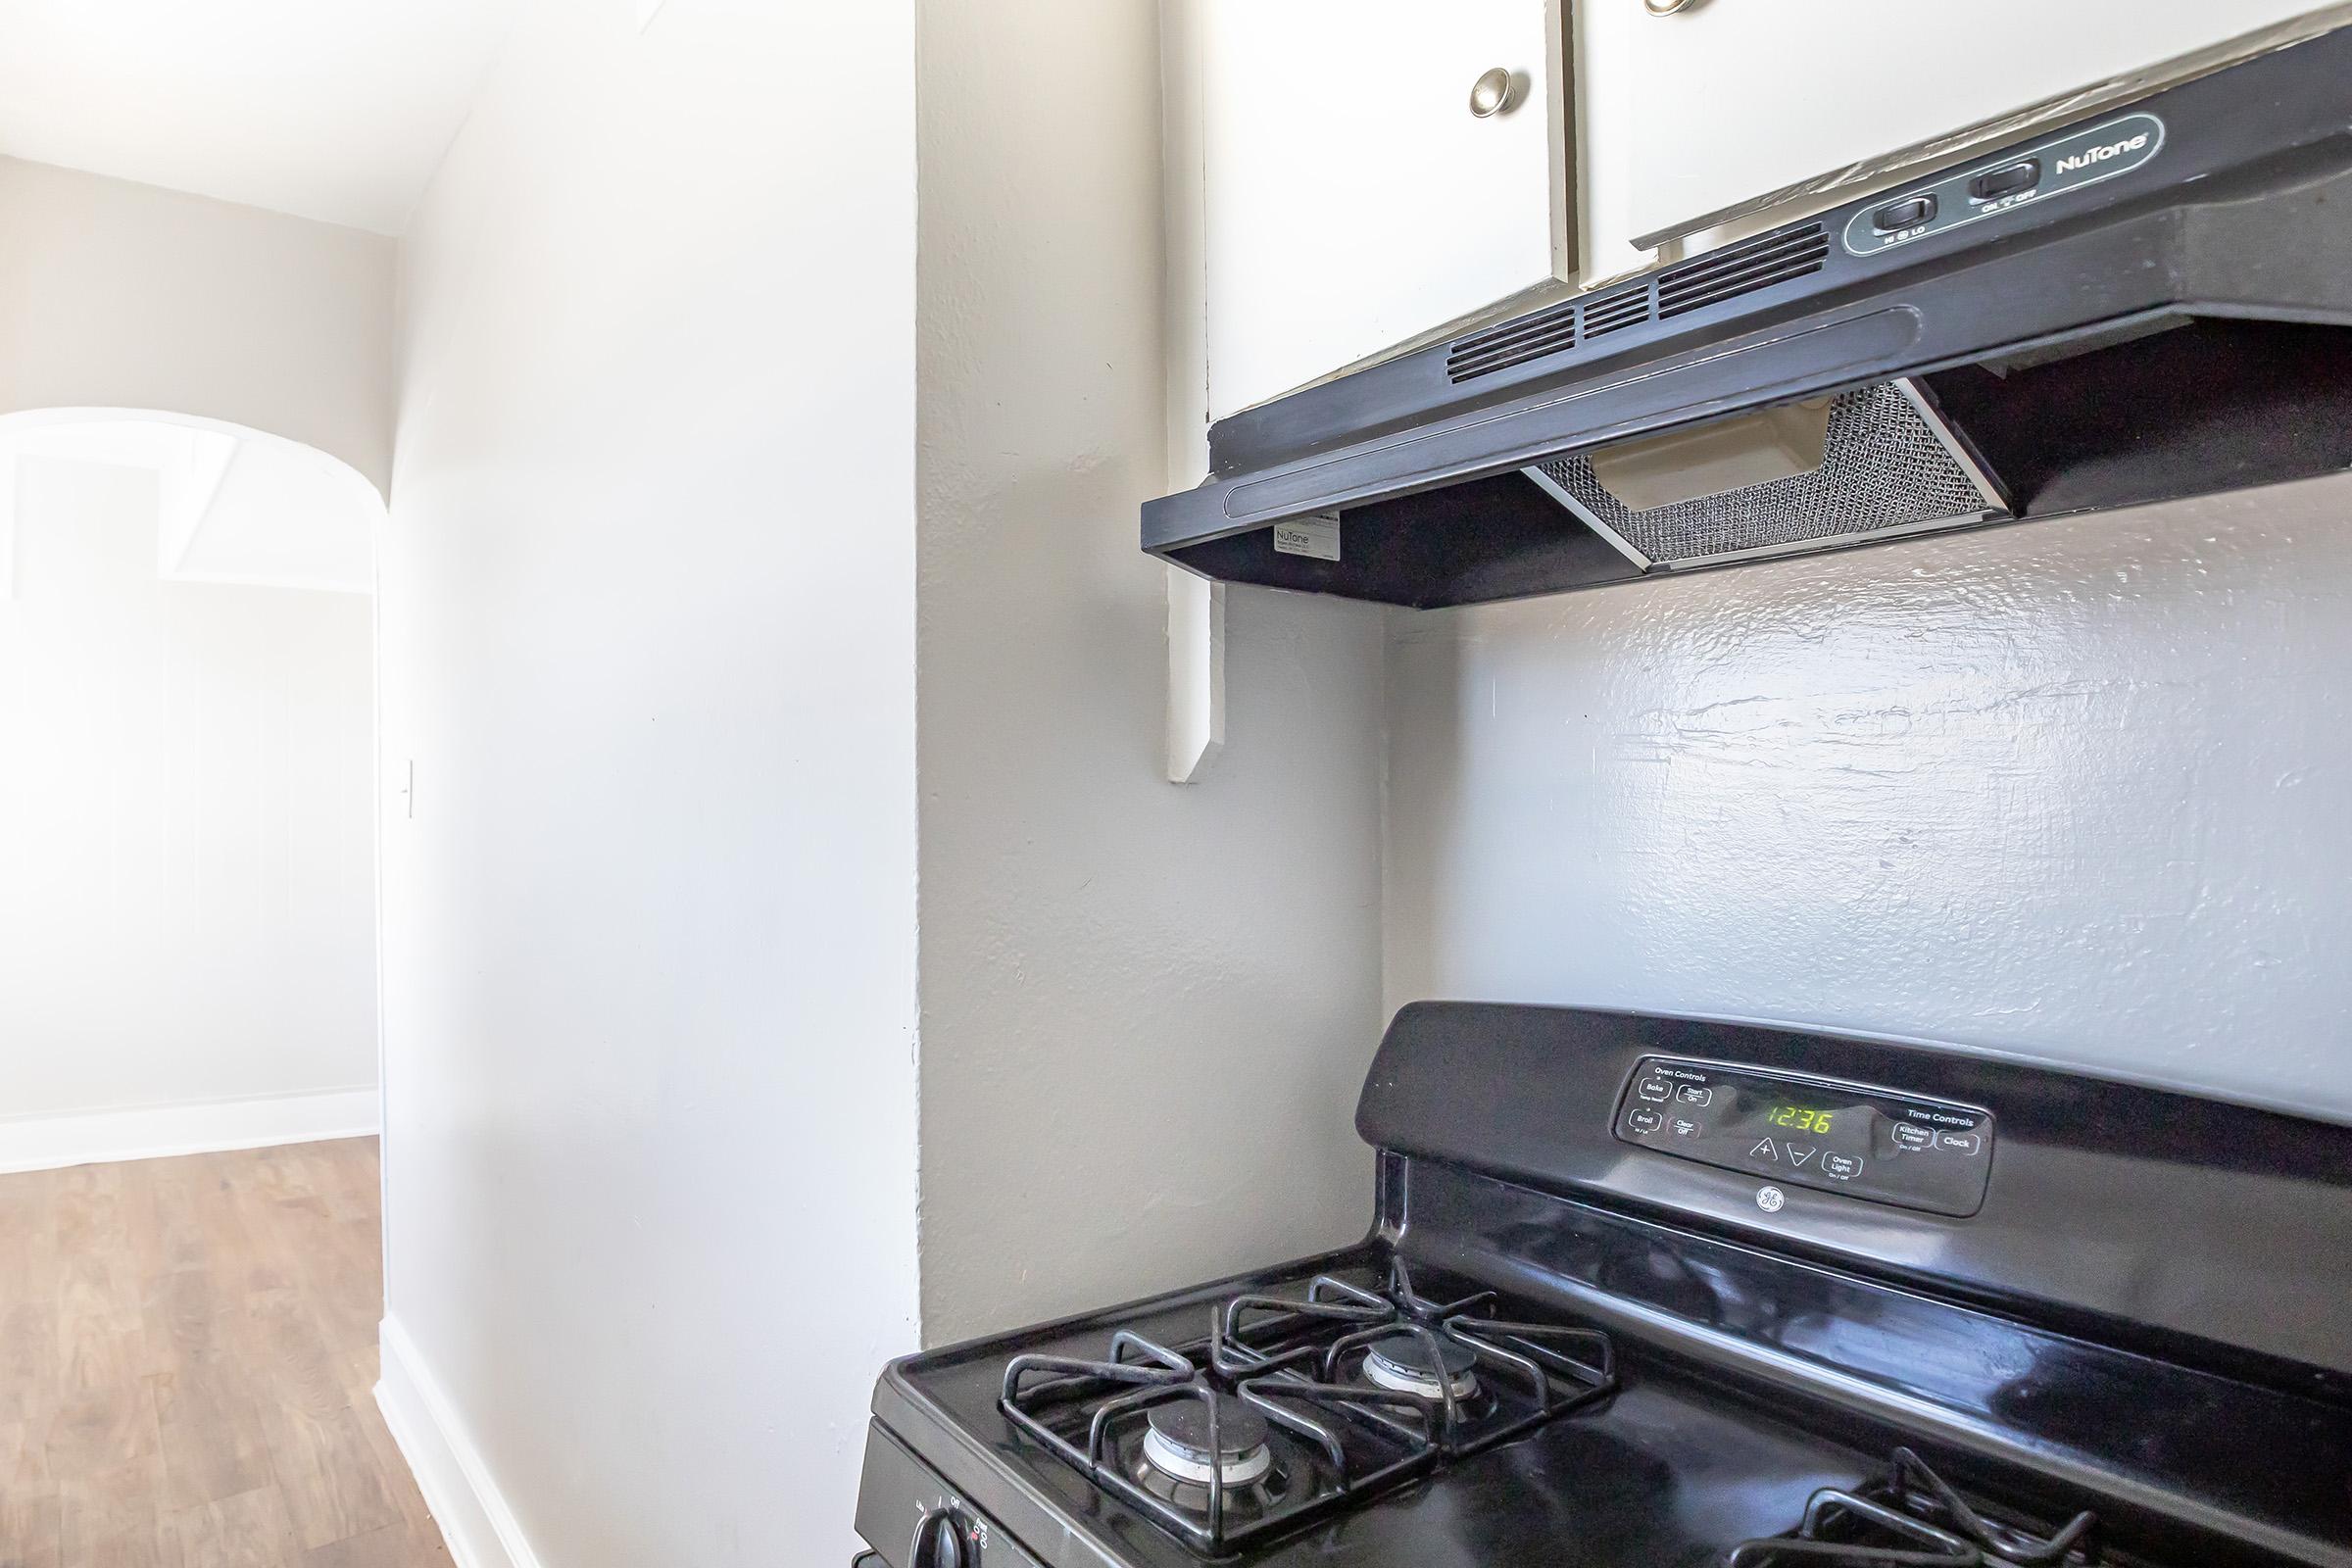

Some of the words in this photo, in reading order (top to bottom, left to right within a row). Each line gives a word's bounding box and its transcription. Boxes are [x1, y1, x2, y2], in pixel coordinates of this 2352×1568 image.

[2056, 134, 2148, 174] NuTone
[2015, 189, 2036, 202] OFF
[1911, 225, 1926, 236] LO
[1277, 530, 1308, 544] NuTone
[1654, 1066, 1674, 1076] Oven
[1674, 1071, 1706, 1082] Controls
[1646, 1083, 1664, 1092] Bake
[1637, 1115, 1653, 1124] Broil
[1768, 1106, 1834, 1134] 12:36
[1908, 1108, 1932, 1119] Time
[1933, 1113, 1975, 1127] Controls
[1676, 1119, 1693, 1128] Clear
[1899, 1126, 1930, 1137] Kitchen
[1901, 1134, 1925, 1143] Timer
[1943, 1137, 1970, 1148] Clock
[1833, 1156, 1852, 1165] Oven
[1831, 1163, 1851, 1173] Light
[950, 1495, 960, 1509] Off
